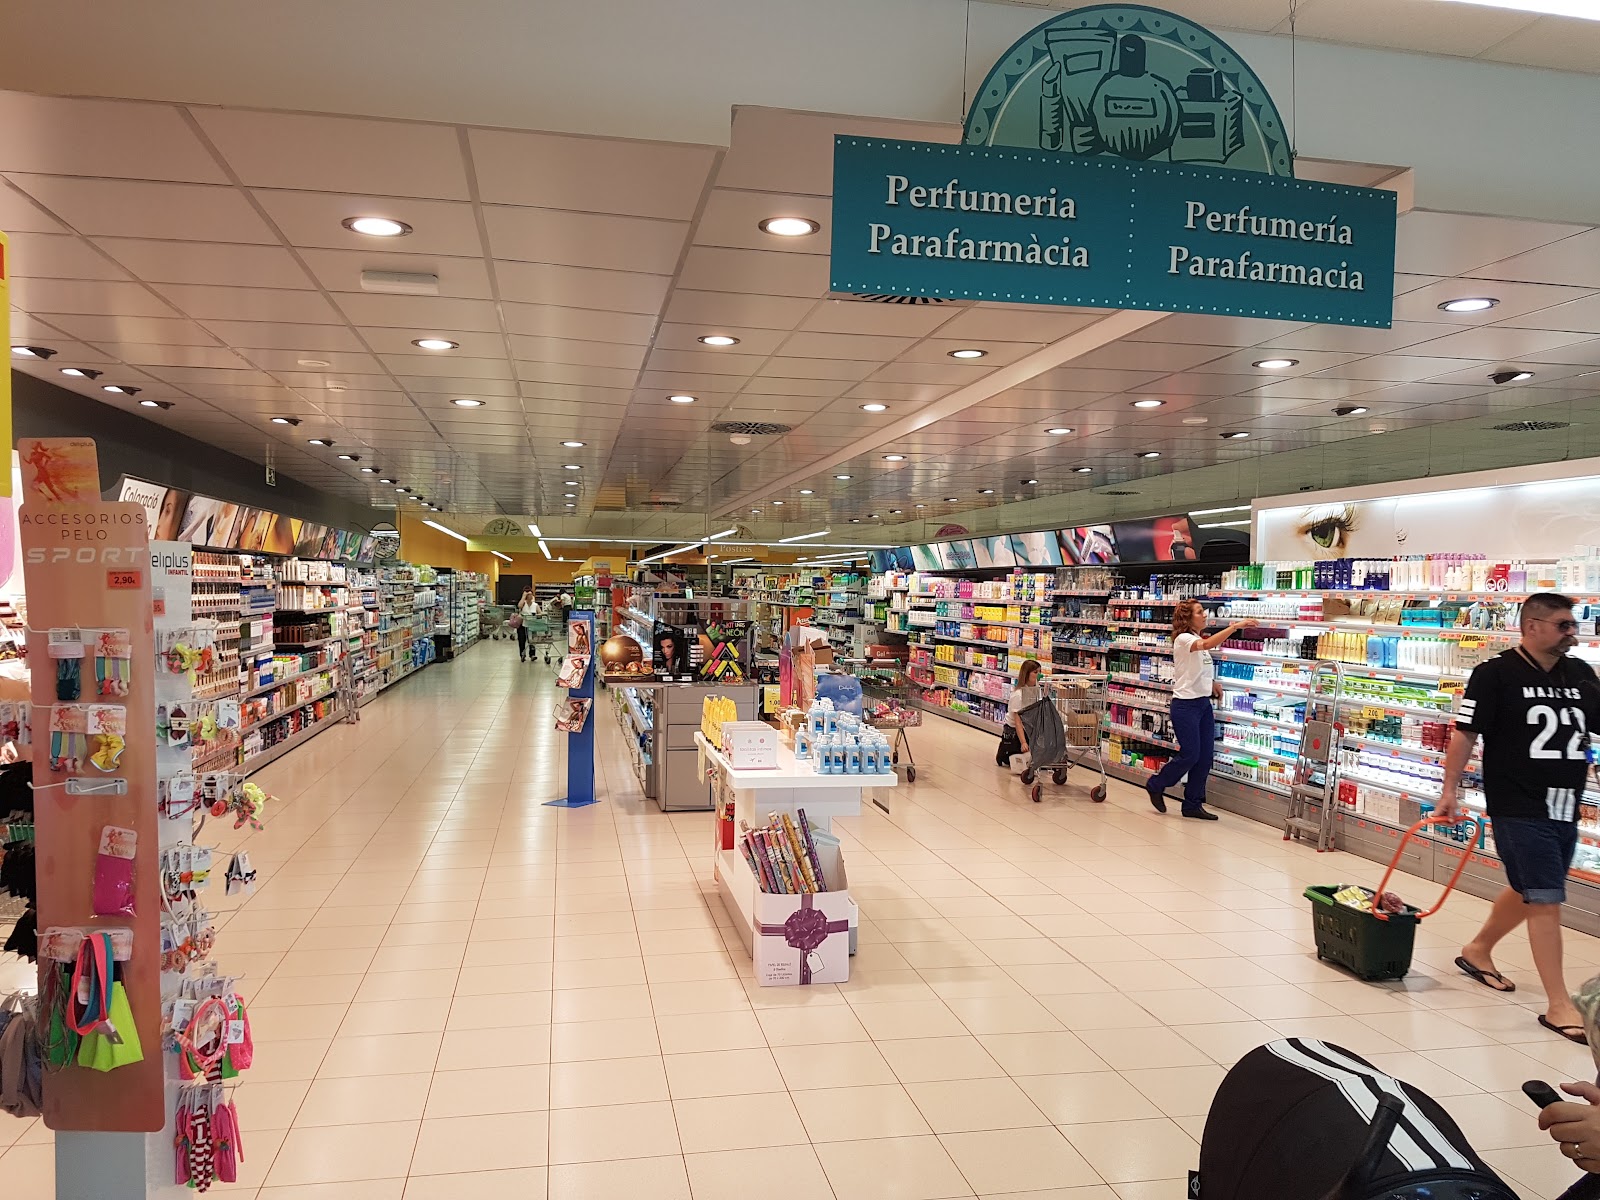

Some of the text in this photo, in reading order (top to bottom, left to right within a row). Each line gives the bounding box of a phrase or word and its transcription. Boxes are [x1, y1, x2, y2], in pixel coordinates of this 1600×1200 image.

[885, 174, 1076, 219] Perfumeria
[1184, 200, 1353, 245] Perfumería
[867, 223, 1089, 268] Parafarmàcia
[1167, 245, 1364, 290] Parafarmacia
[22, 513, 144, 525] ACCESORIOS
[61, 529, 107, 540] PELO
[26, 547, 145, 563] SPORT
[150, 551, 189, 575] eliplus
[720, 545, 753, 553] Postres
[1526, 704, 1587, 760] 22
